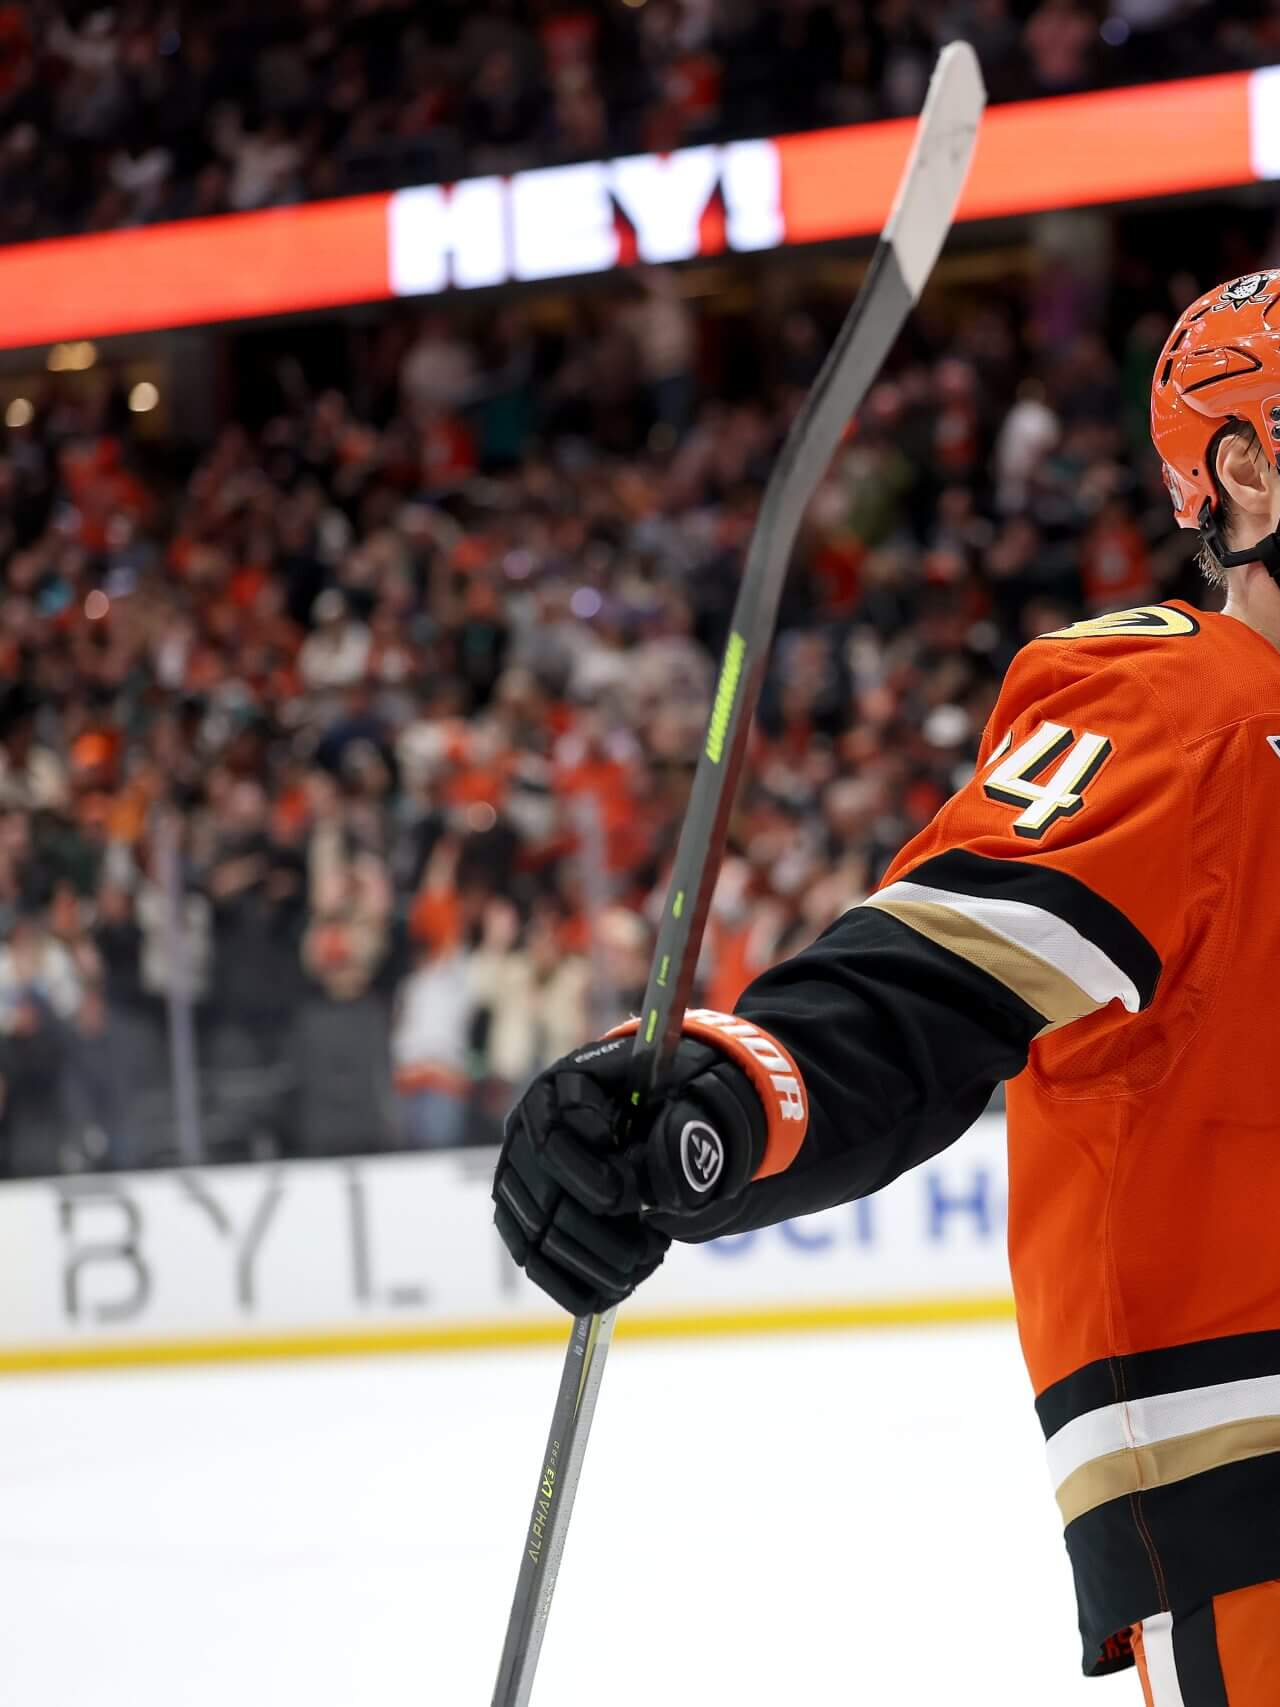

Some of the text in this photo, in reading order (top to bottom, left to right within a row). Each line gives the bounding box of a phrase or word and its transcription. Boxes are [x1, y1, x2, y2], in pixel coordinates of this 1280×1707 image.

[389, 138, 785, 297] HEY!
[983, 720, 1113, 840] 4
[684, 1007, 804, 1121] RIOR
